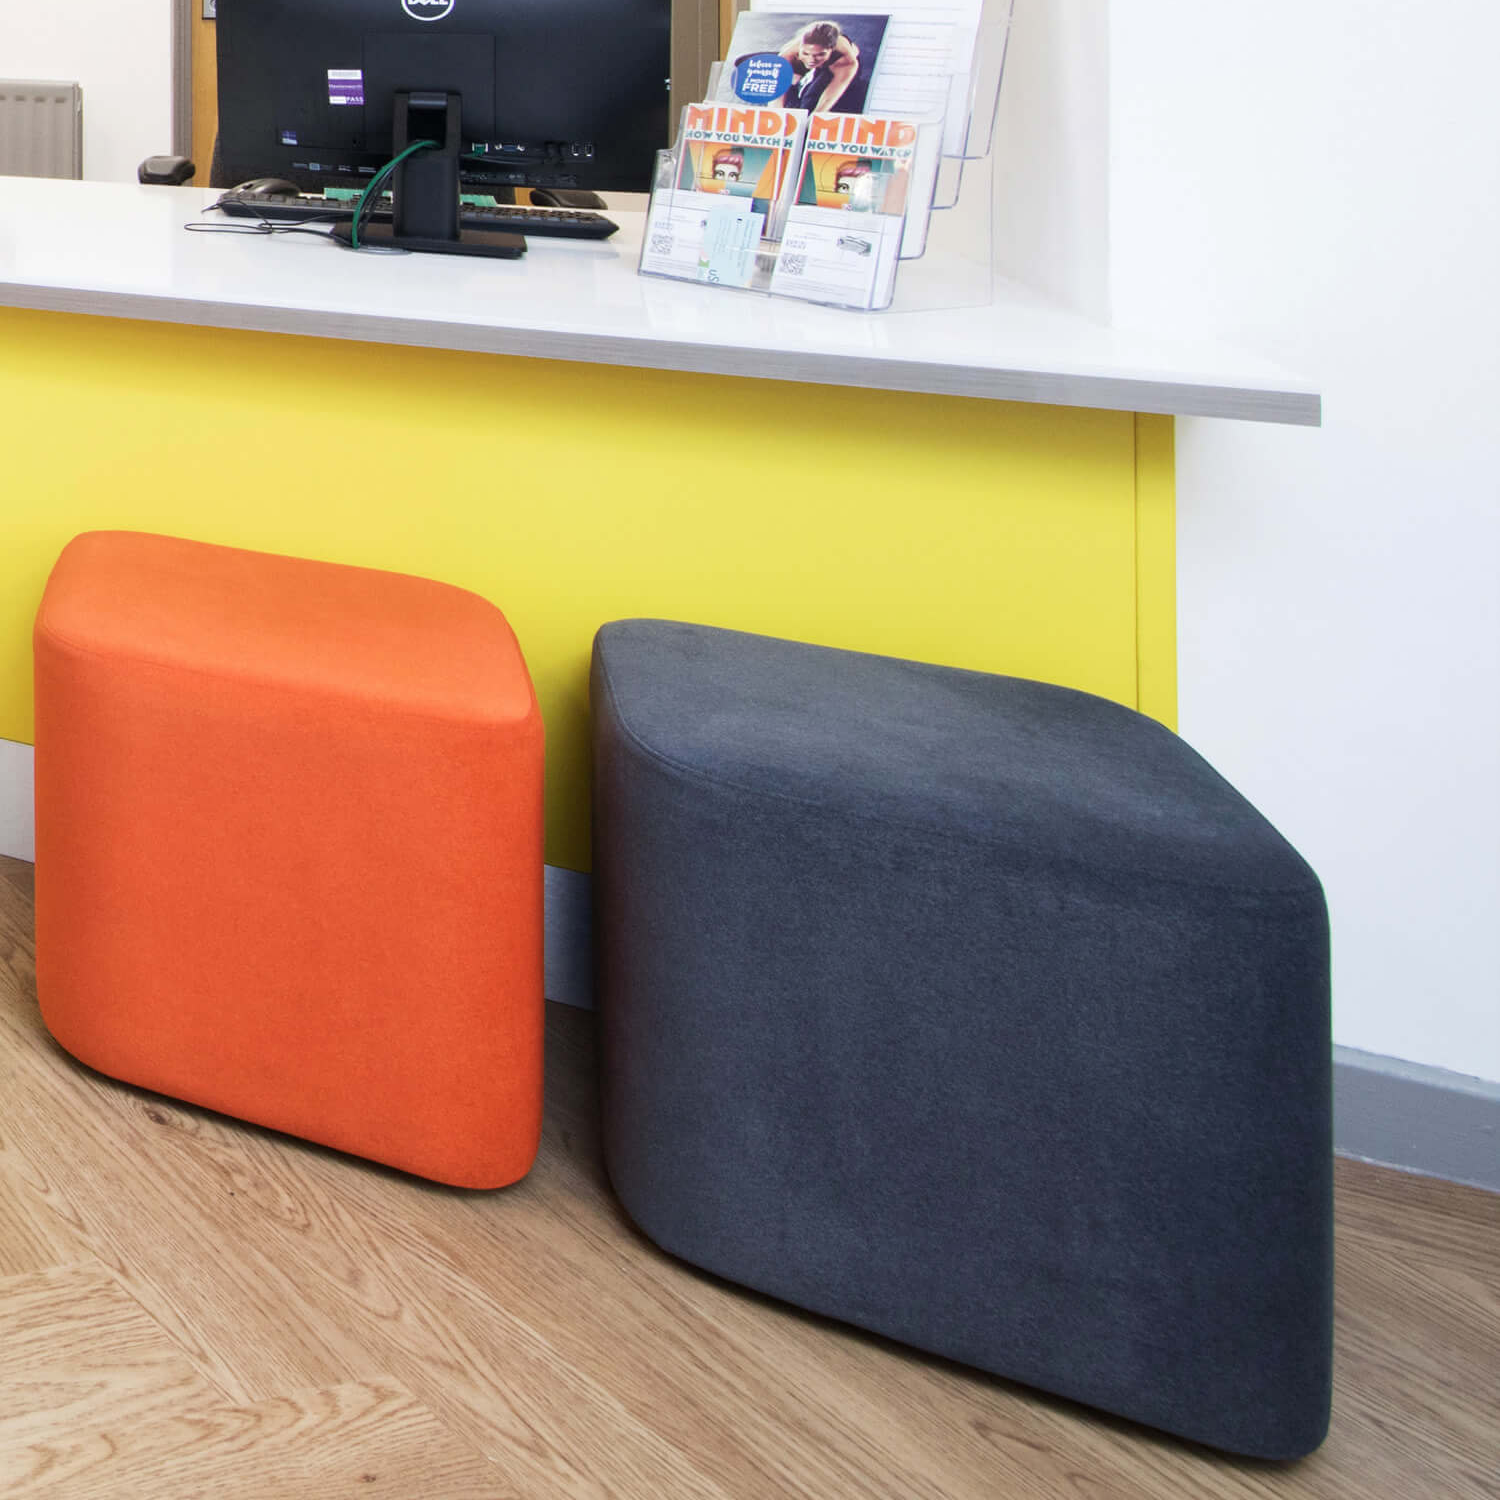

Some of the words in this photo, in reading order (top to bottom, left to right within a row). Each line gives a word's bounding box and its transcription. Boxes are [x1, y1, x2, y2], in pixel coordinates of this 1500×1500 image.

[742, 83, 777, 93] FREE
[687, 106, 783, 137] MIND
[686, 130, 714, 140] HOW
[716, 132, 740, 142] YOU
[742, 135, 781, 147] WATCH
[809, 115, 916, 148] MIND
[807, 141, 839, 151] HOW
[840, 143, 868, 154] YOU
